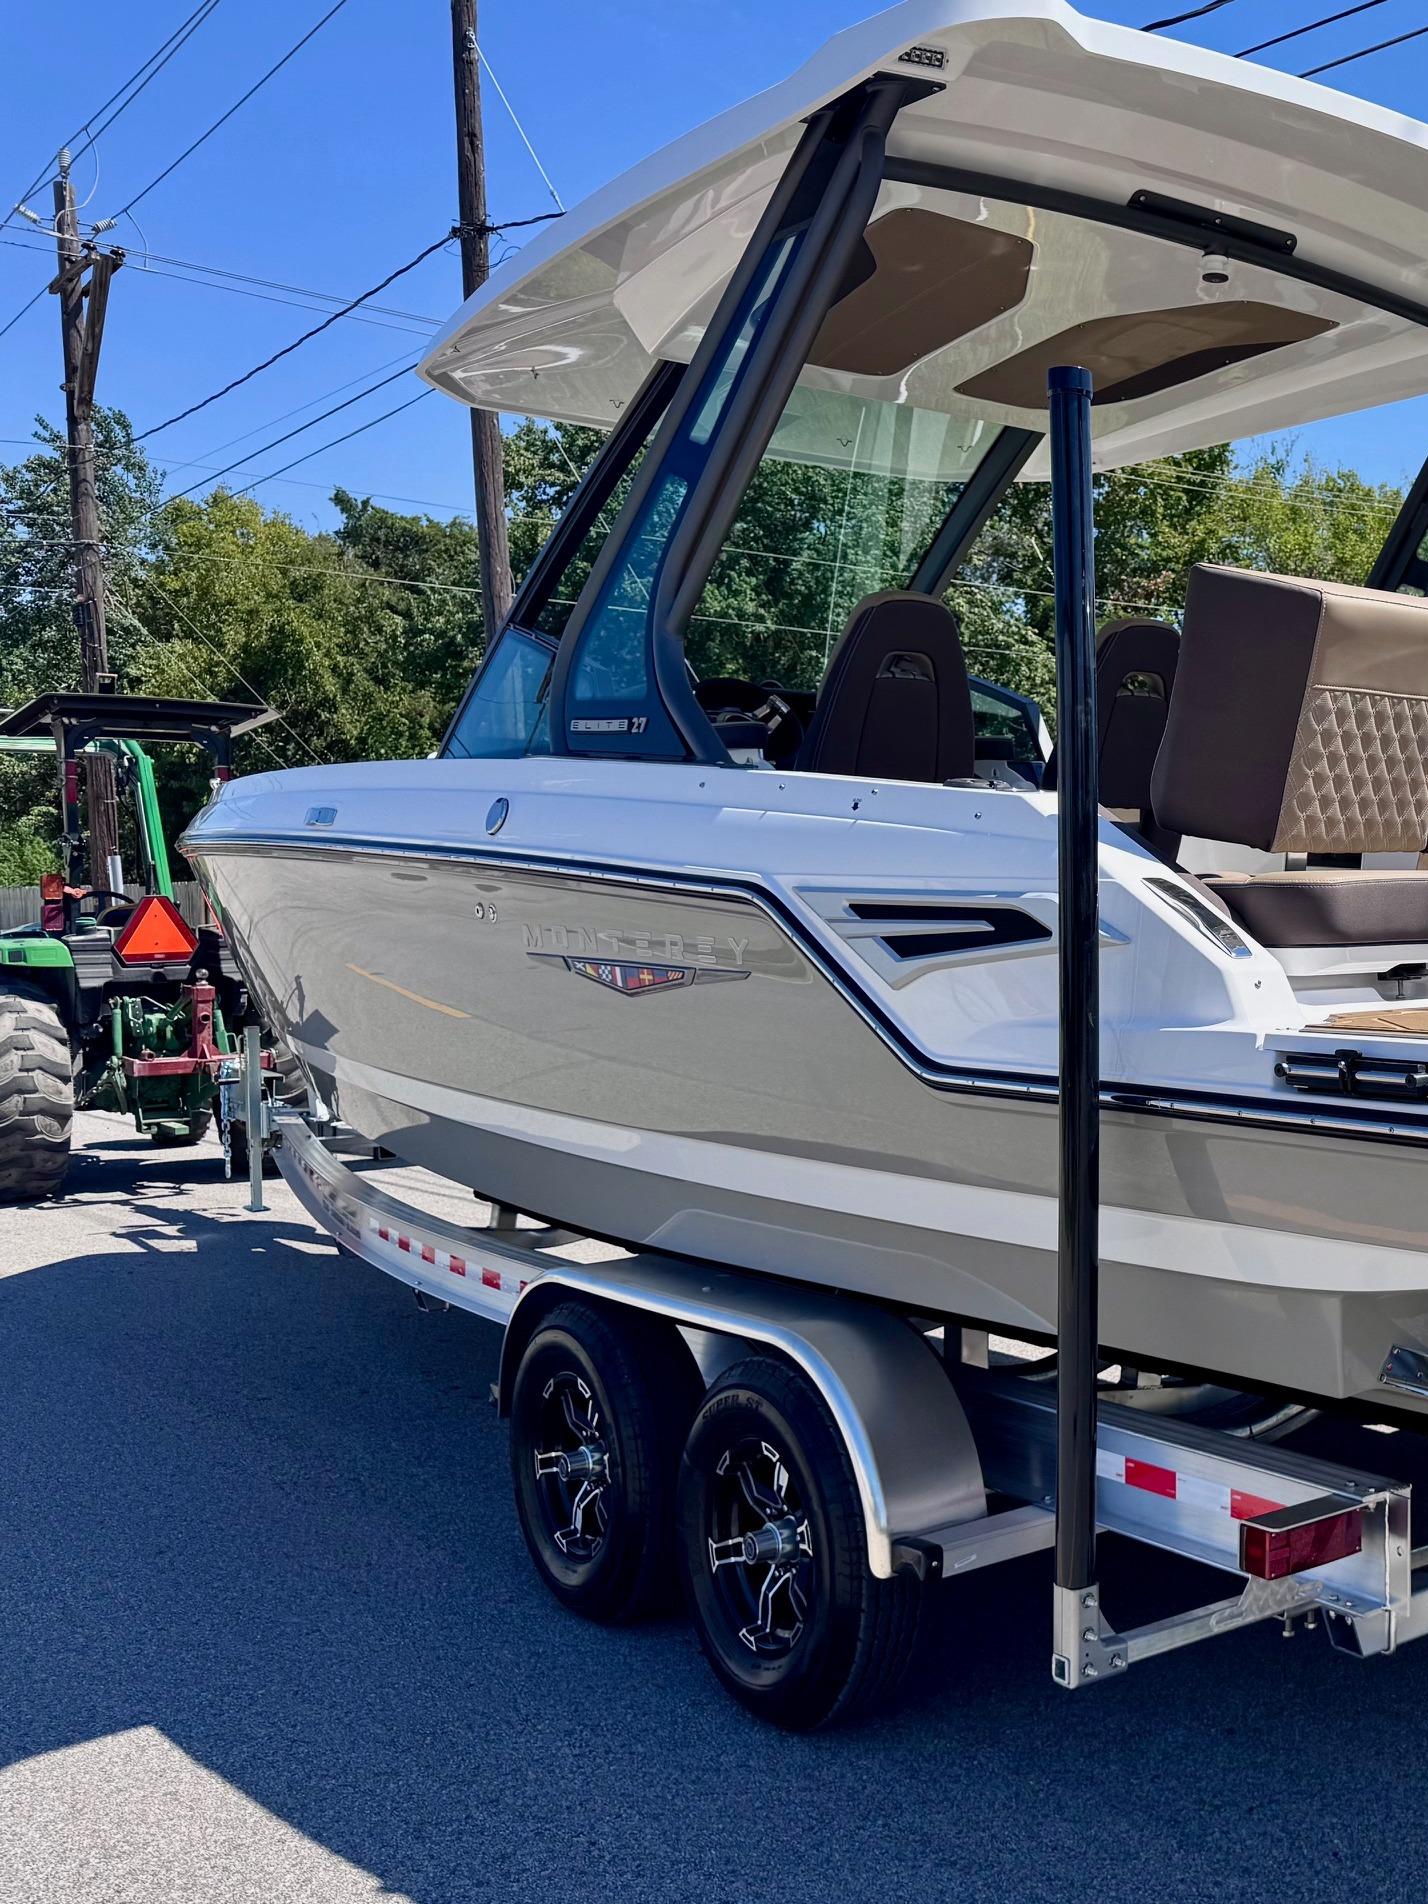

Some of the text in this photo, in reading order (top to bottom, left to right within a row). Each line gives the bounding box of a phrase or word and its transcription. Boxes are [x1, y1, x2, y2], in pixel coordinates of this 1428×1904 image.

[572, 717, 648, 733] ELITE 27
[522, 923, 749, 965] MONTEREY
